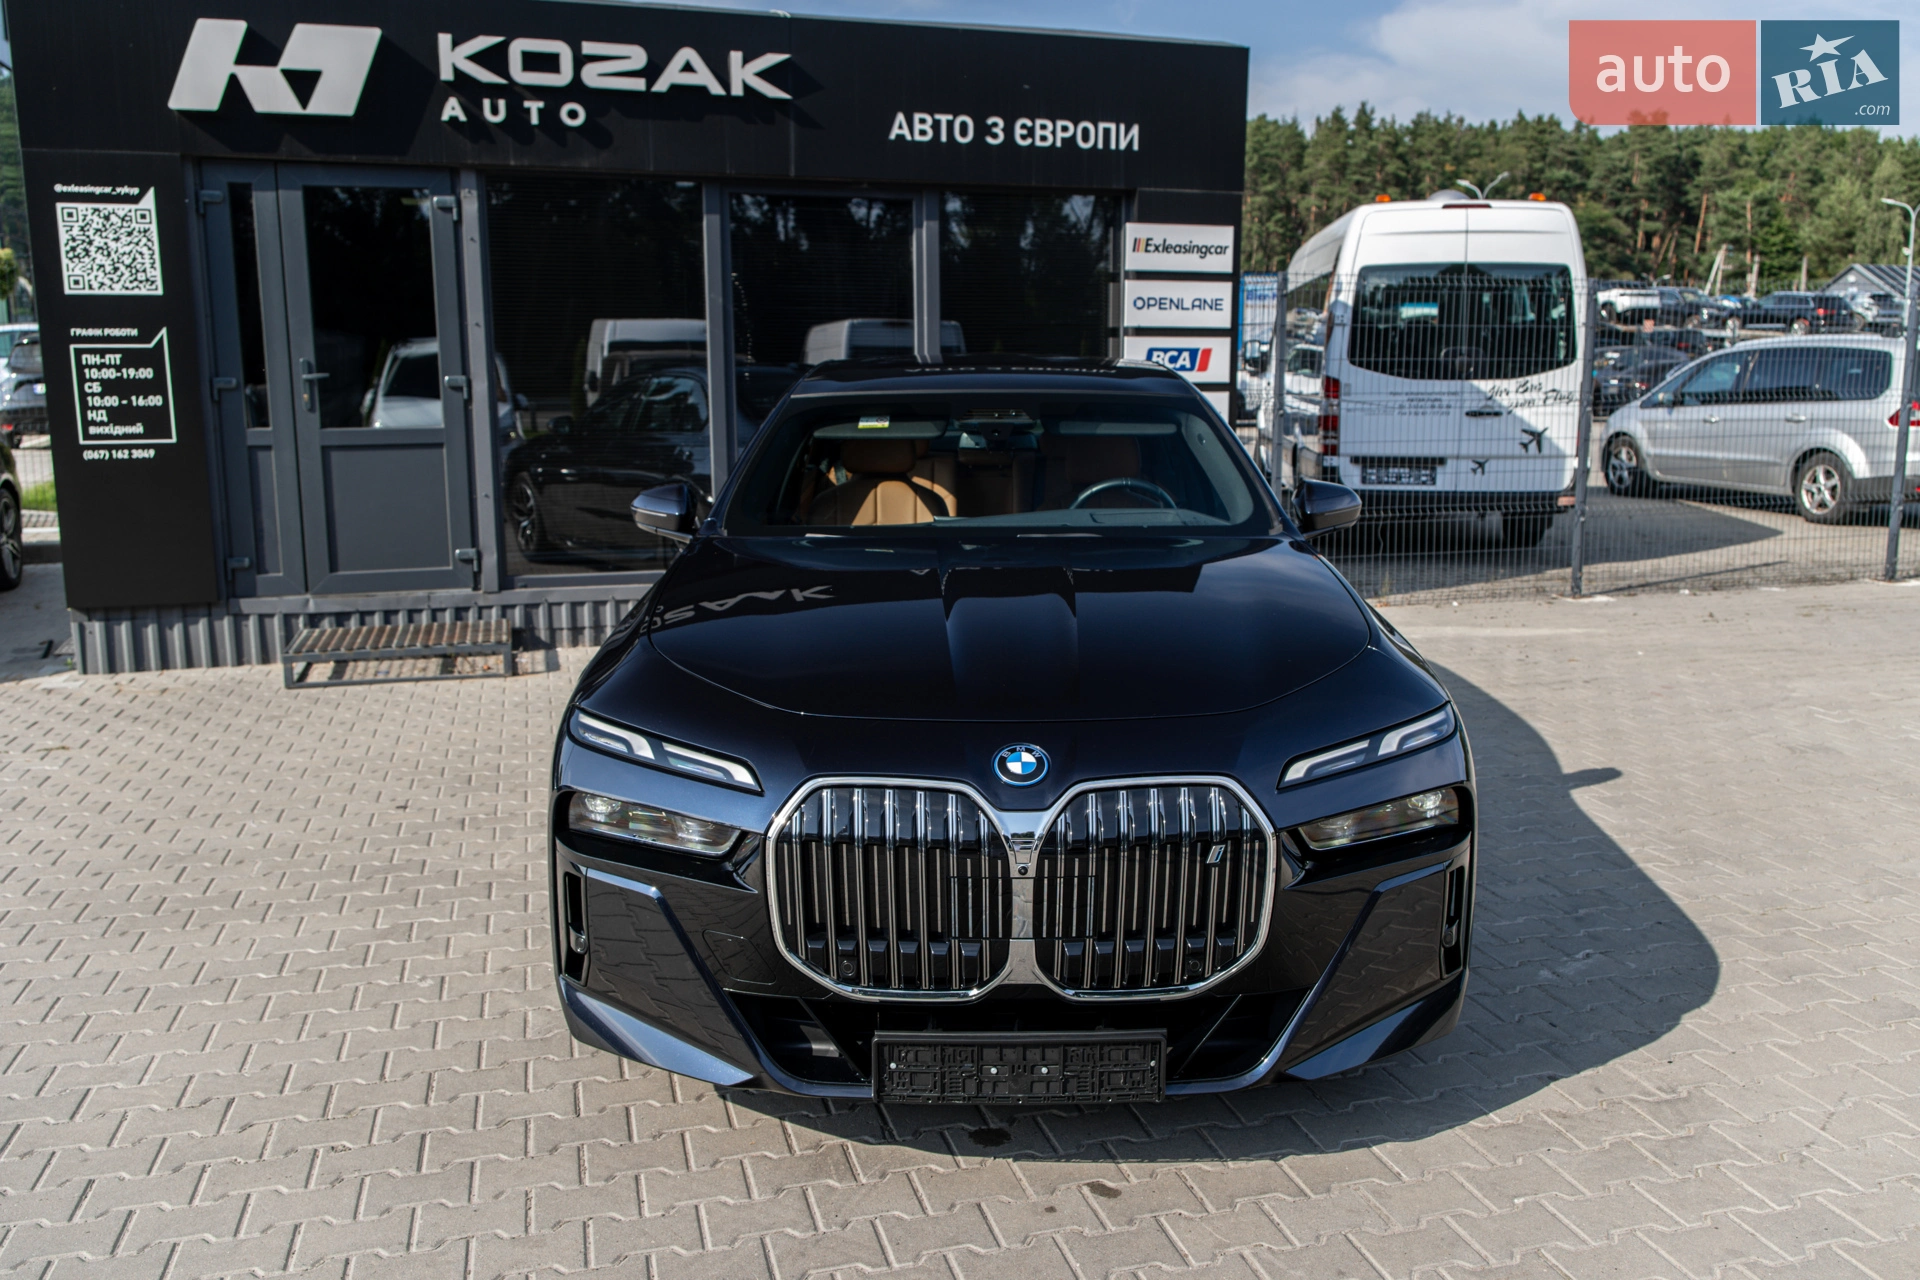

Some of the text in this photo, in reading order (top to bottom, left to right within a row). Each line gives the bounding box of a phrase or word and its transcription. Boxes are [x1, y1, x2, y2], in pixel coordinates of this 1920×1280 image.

[437, 32, 793, 100] KOZAK
[440, 96, 587, 127] AUTO
[888, 111, 1140, 151] АВТО З ЄВРОПИ
[1144, 237, 1230, 259] Exleasingcar
[1133, 296, 1225, 311] OPENLANE
[104, 328, 138, 337] РОБОТИ
[81, 354, 122, 365] ПН-ПТ
[1152, 350, 1192, 369] BCA
[84, 368, 154, 379] 10:00-19:00
[84, 382, 102, 393] СБ
[86, 396, 119, 407] 10:00
[130, 395, 163, 407] 16:00
[87, 409, 108, 422] НД
[88, 423, 144, 436] вихідний
[82, 448, 155, 460] (067) 162 3049
[1001, 746, 1042, 758] BMW
